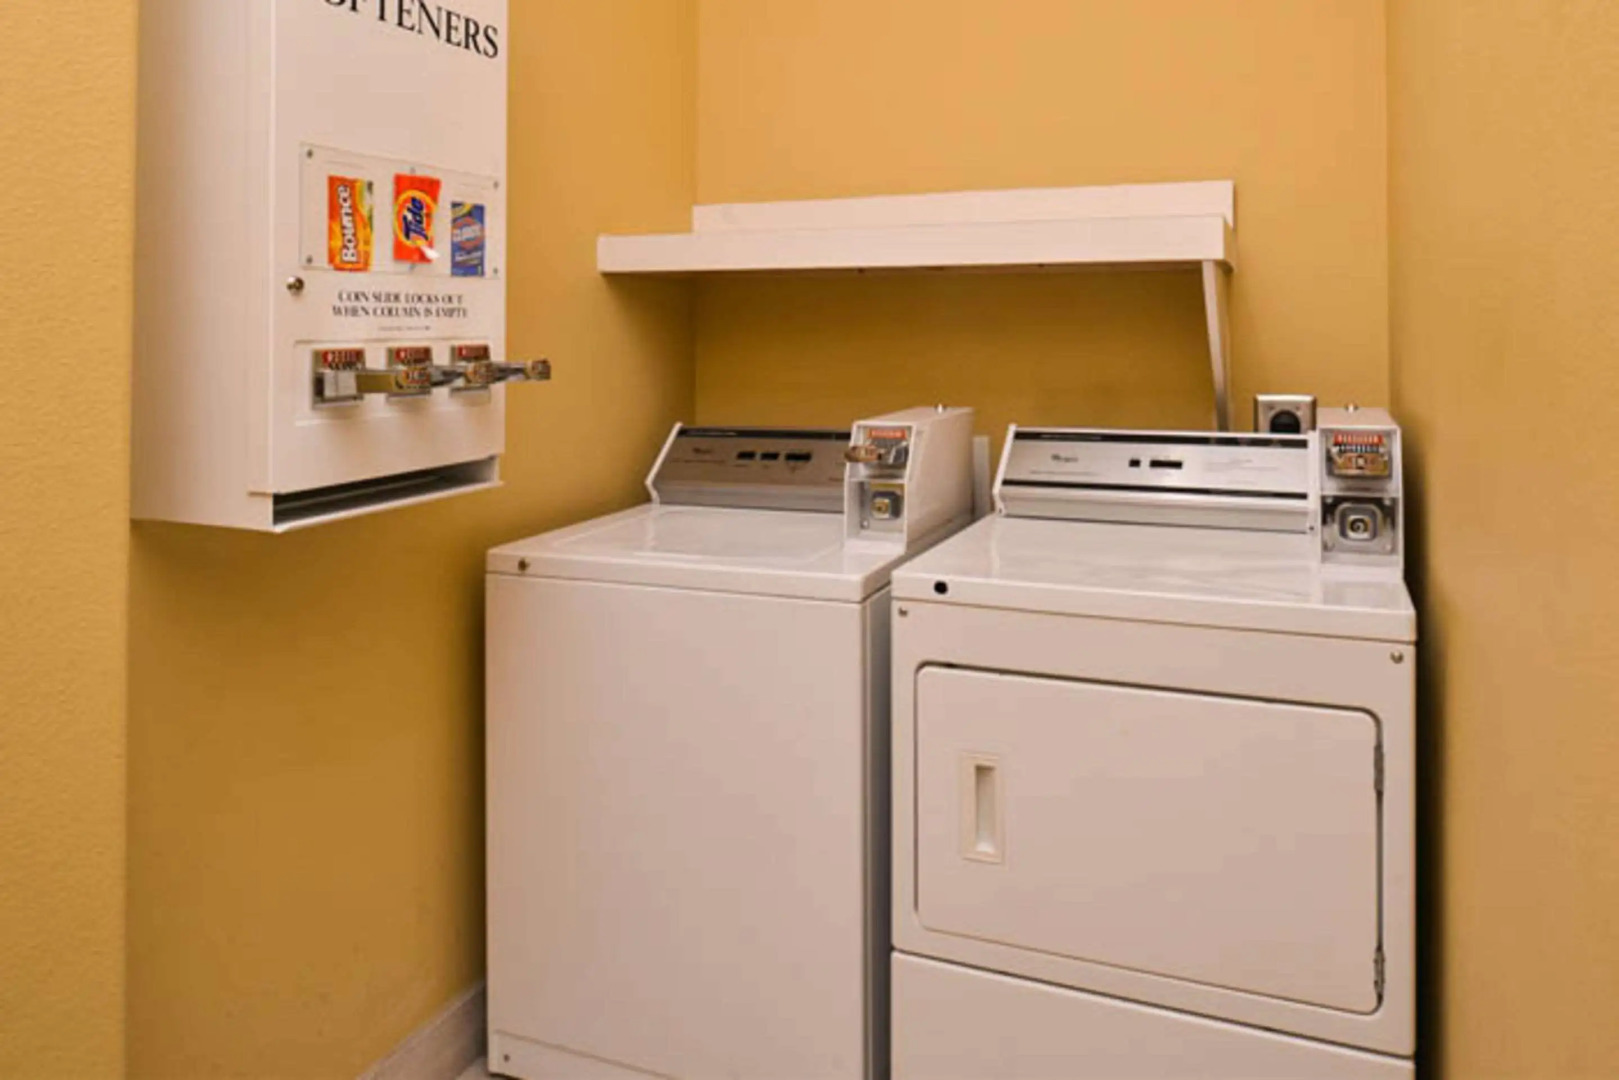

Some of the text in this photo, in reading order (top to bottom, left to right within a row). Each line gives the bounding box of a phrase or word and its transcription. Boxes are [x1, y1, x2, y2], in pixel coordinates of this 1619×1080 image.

[325, 0, 499, 59] TENERS
[338, 184, 358, 262] Bounce
[403, 196, 429, 241] Tide
[332, 305, 467, 318] WHEN COLUMN IS EMPTY
[337, 290, 463, 304] COIN SLIDE LOCKS OUT
